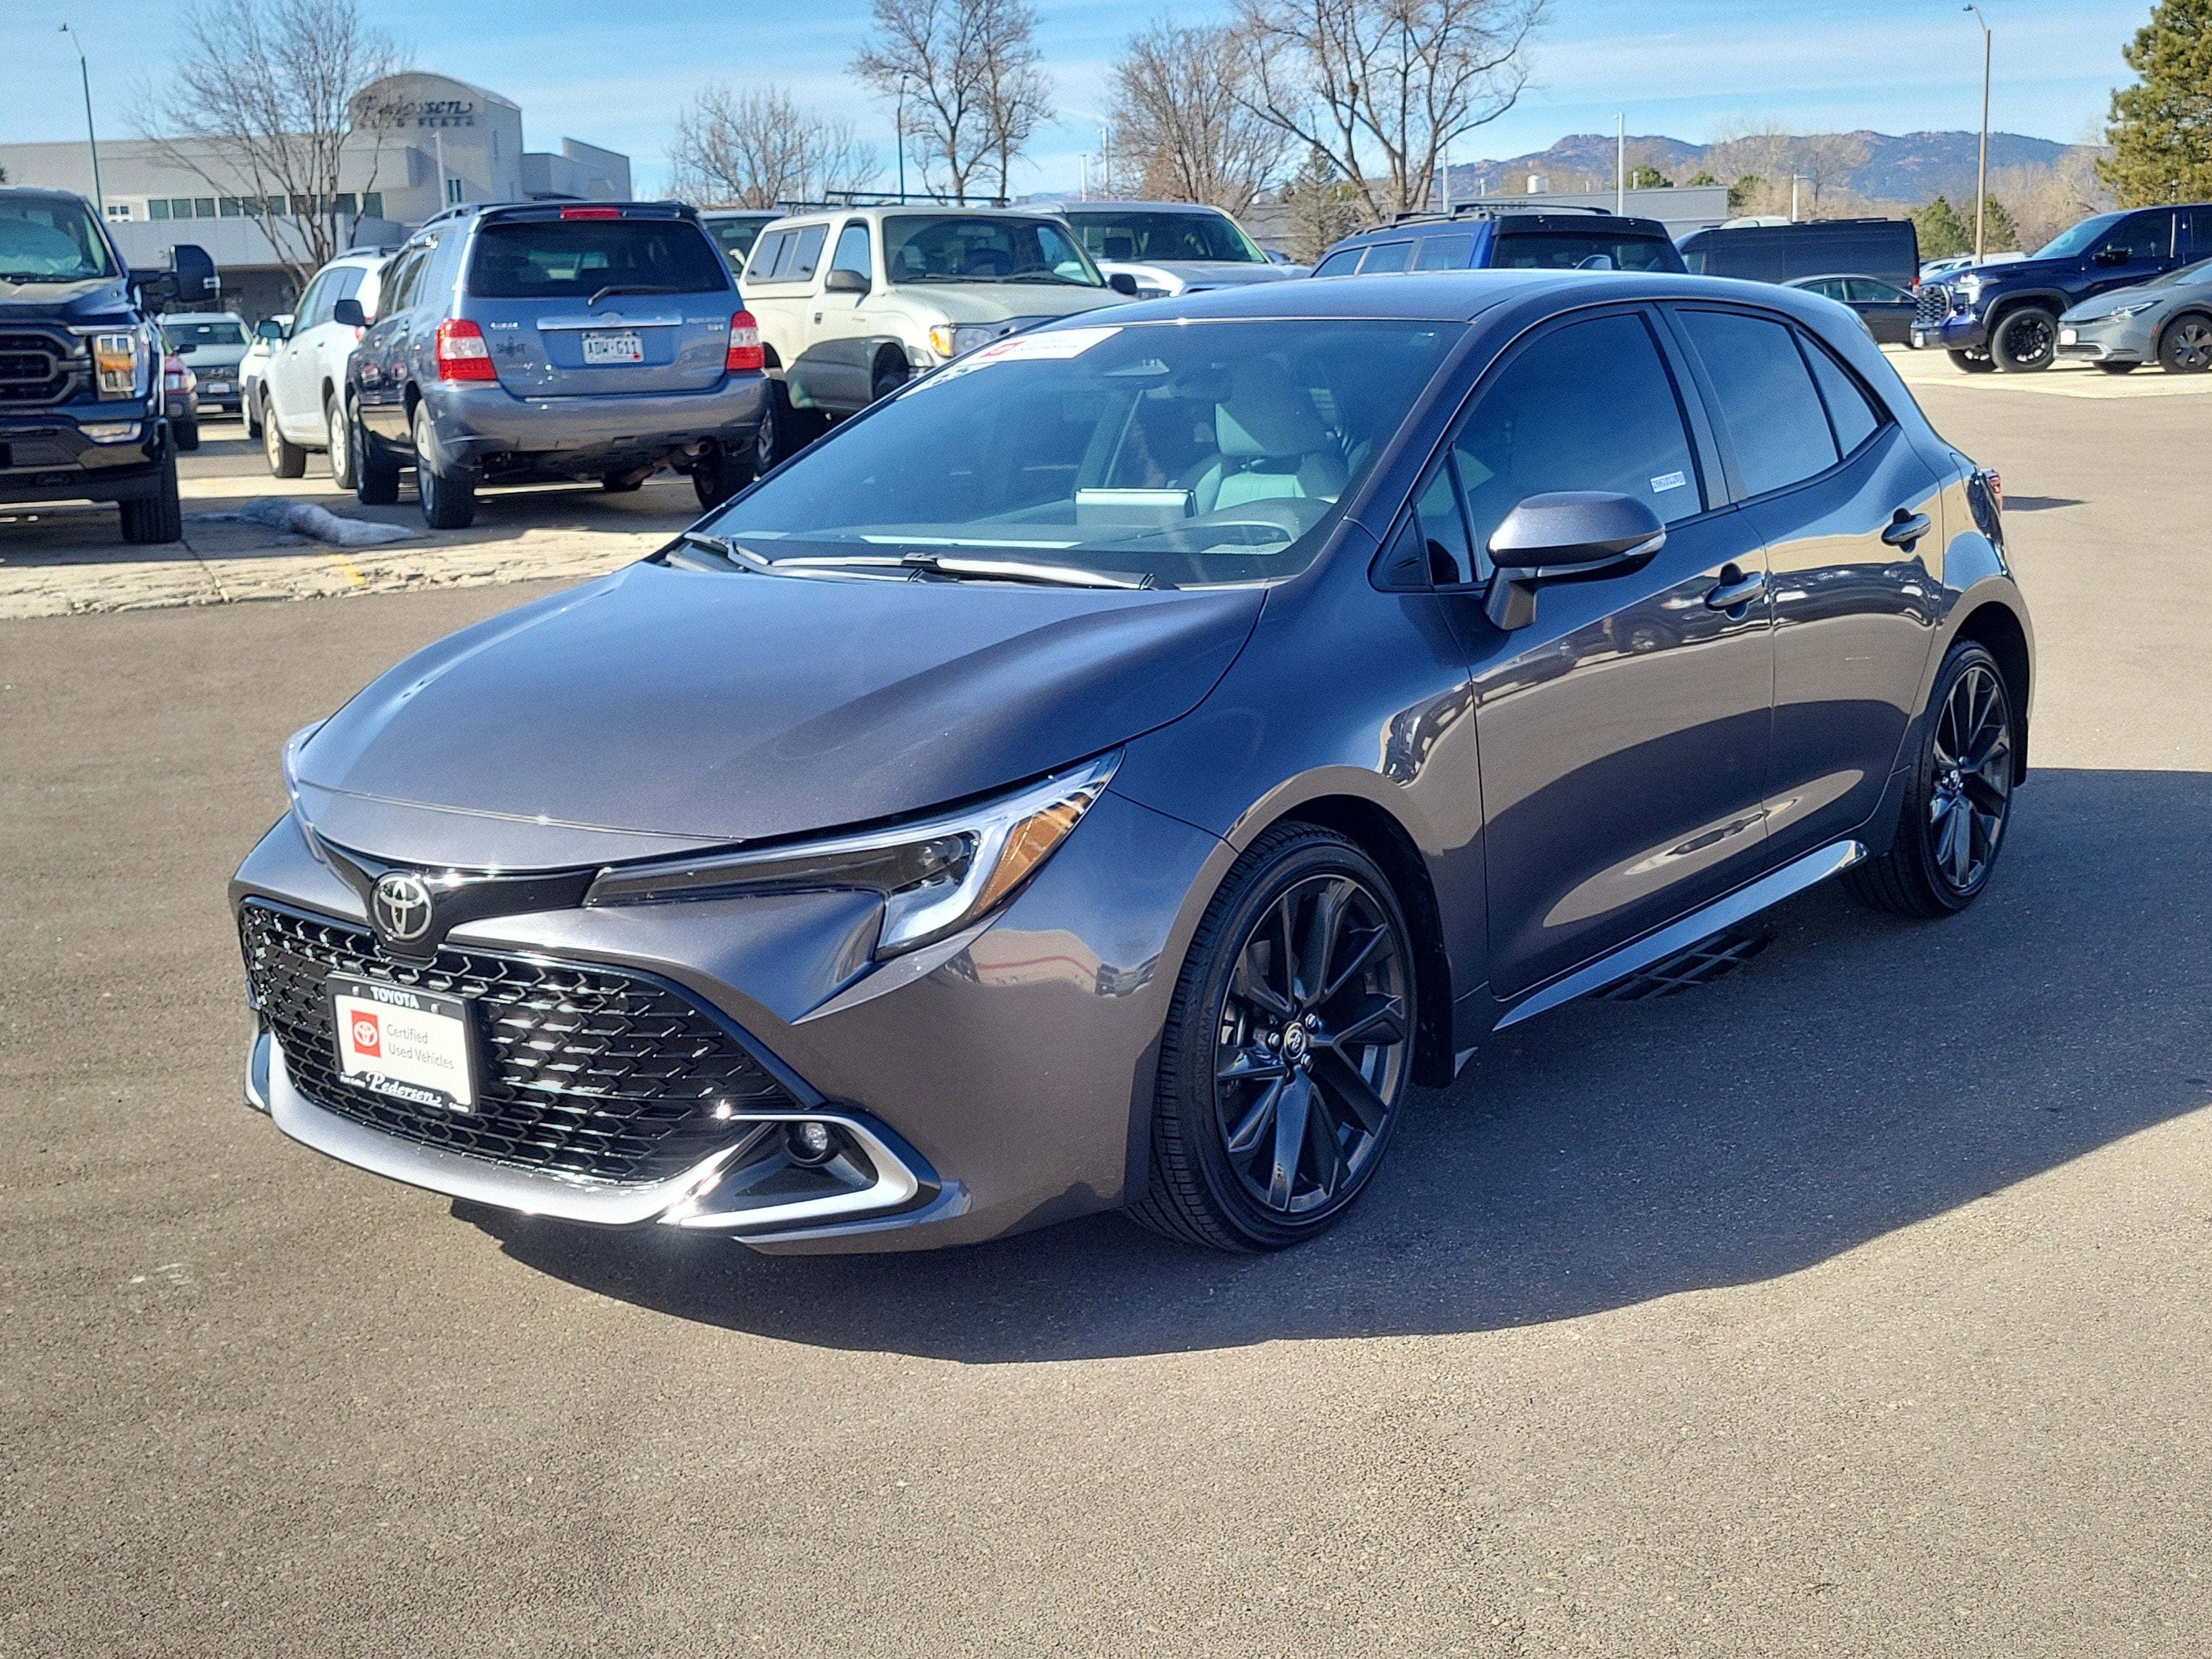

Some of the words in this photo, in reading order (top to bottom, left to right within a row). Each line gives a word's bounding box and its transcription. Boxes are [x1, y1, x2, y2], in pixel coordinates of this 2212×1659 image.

[370, 986, 420, 1009] TOYOTA
[387, 1024, 428, 1044] Certified
[388, 1042, 413, 1060] Used
[415, 1048, 455, 1070] Vehicles
[366, 1072, 442, 1106] Pedersen
